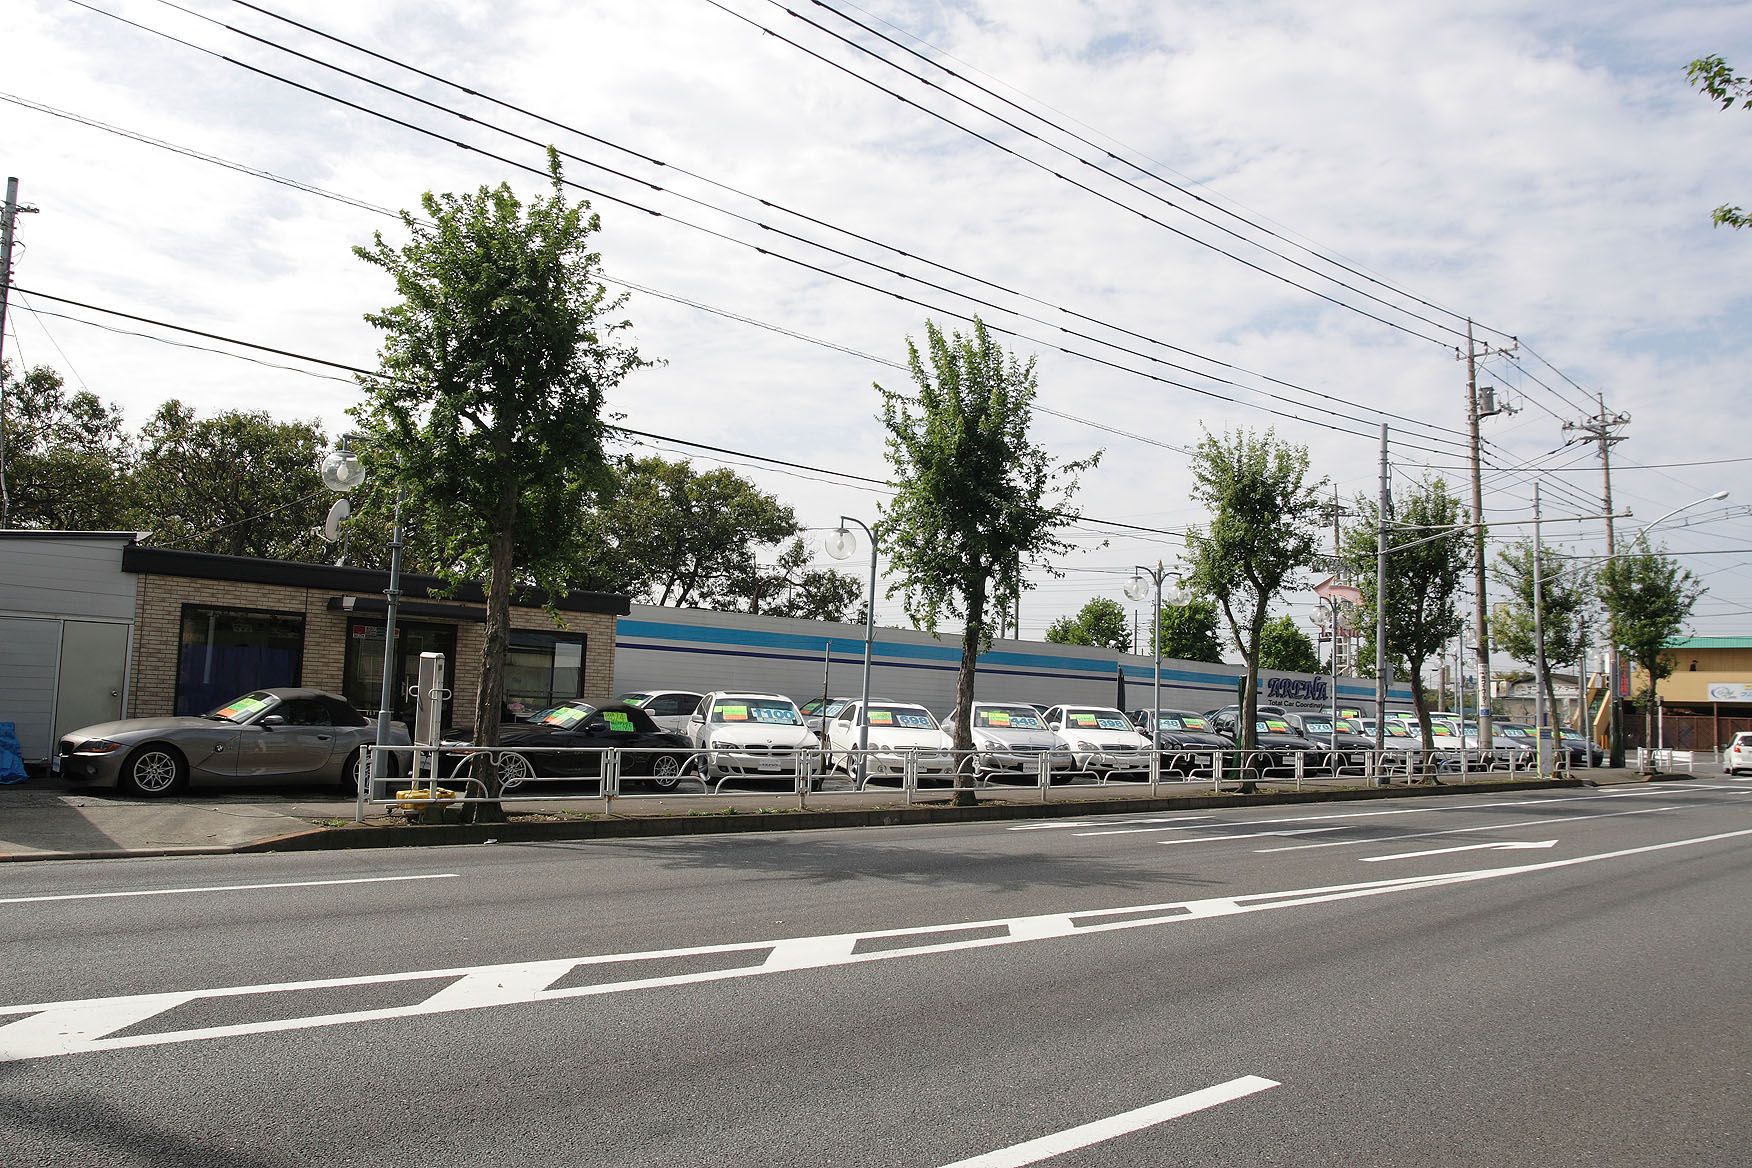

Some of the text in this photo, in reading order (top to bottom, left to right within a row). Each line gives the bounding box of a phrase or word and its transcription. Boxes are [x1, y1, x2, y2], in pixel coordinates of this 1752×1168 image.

[1267, 676, 1329, 700] ARENA
[1295, 701, 1325, 709] Coordinat
[753, 707, 796, 720] 1100
[899, 714, 930, 725] 698
[1010, 717, 1039, 726] 448
[1099, 719, 1125, 729] 398
